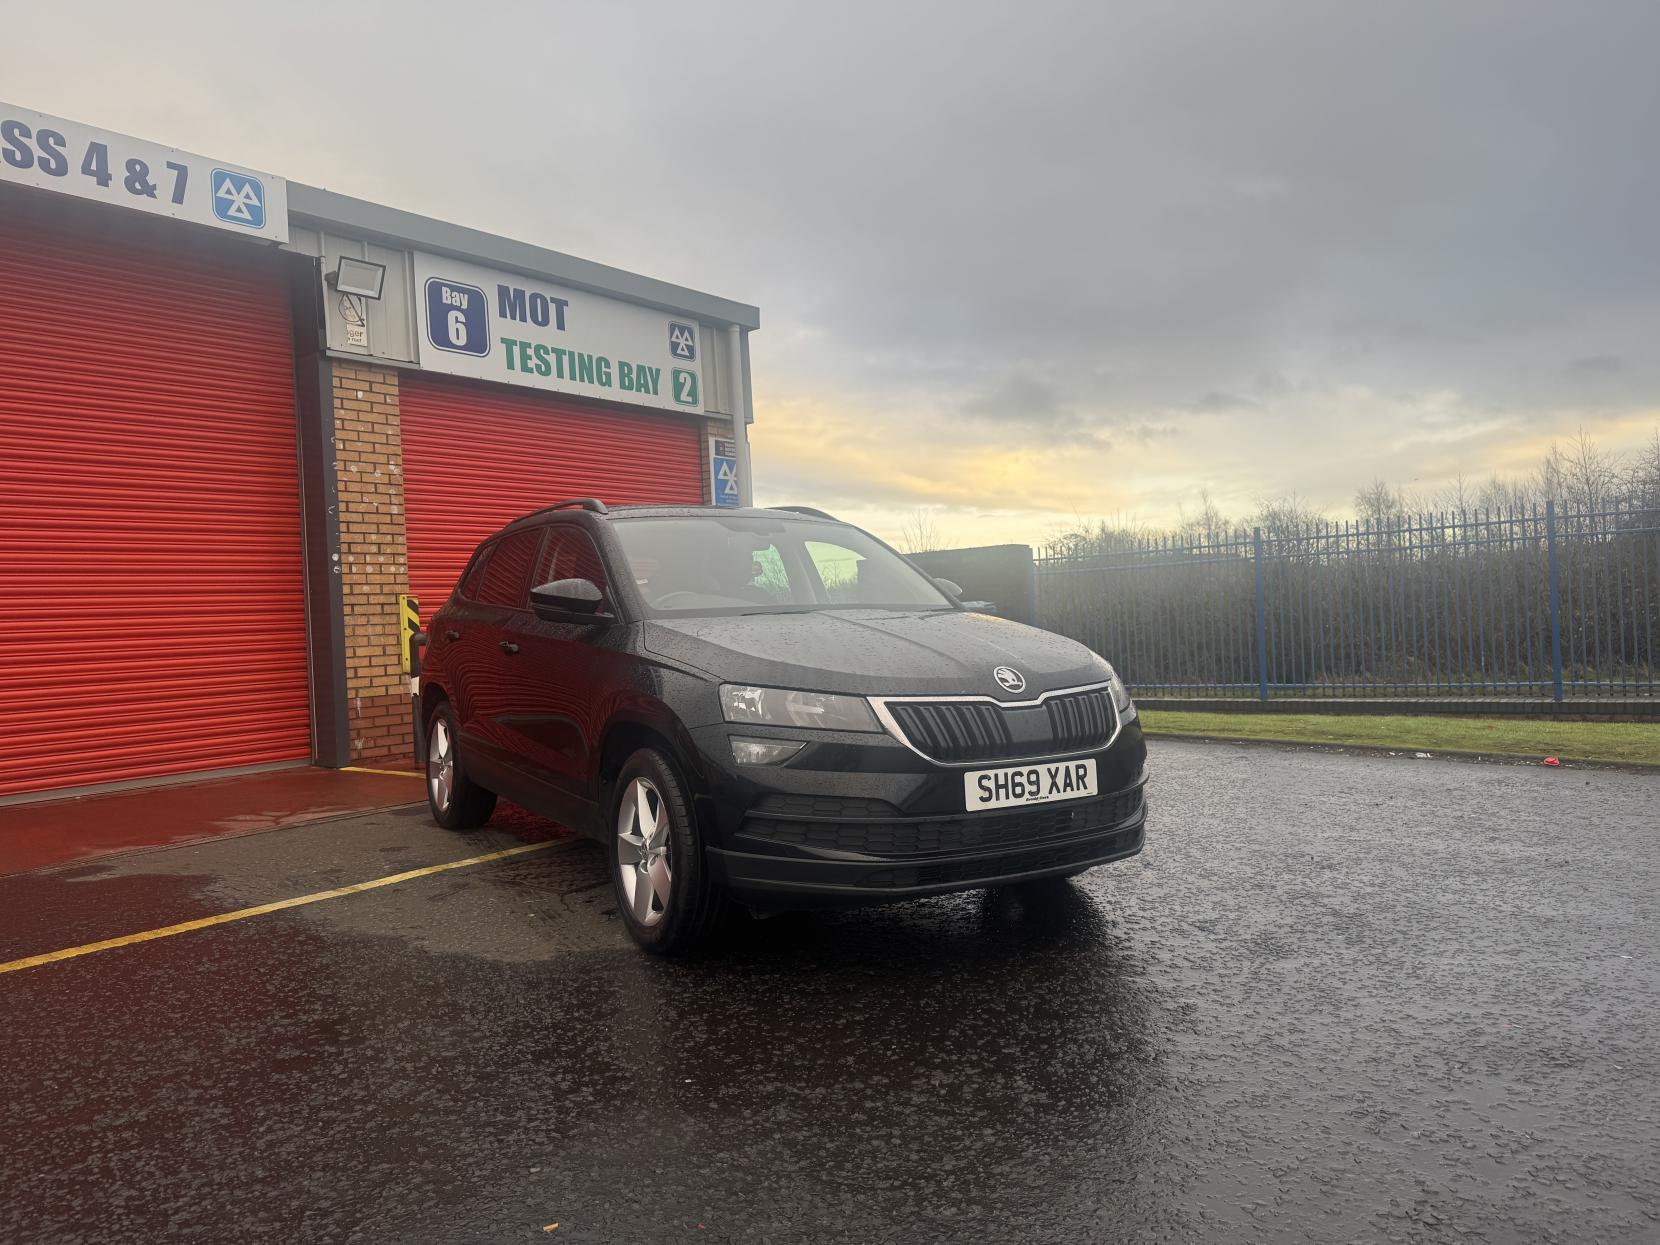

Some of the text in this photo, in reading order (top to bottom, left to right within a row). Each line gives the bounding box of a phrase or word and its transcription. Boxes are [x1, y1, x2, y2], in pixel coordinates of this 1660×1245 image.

[0, 119, 189, 205] SS 4 & 7
[441, 286, 468, 310] Bay
[497, 284, 569, 332] MOT
[447, 310, 467, 346] 6
[500, 337, 661, 396] TESTING BAY
[678, 372, 693, 403] 2
[977, 763, 1088, 803] SH69 XAR
